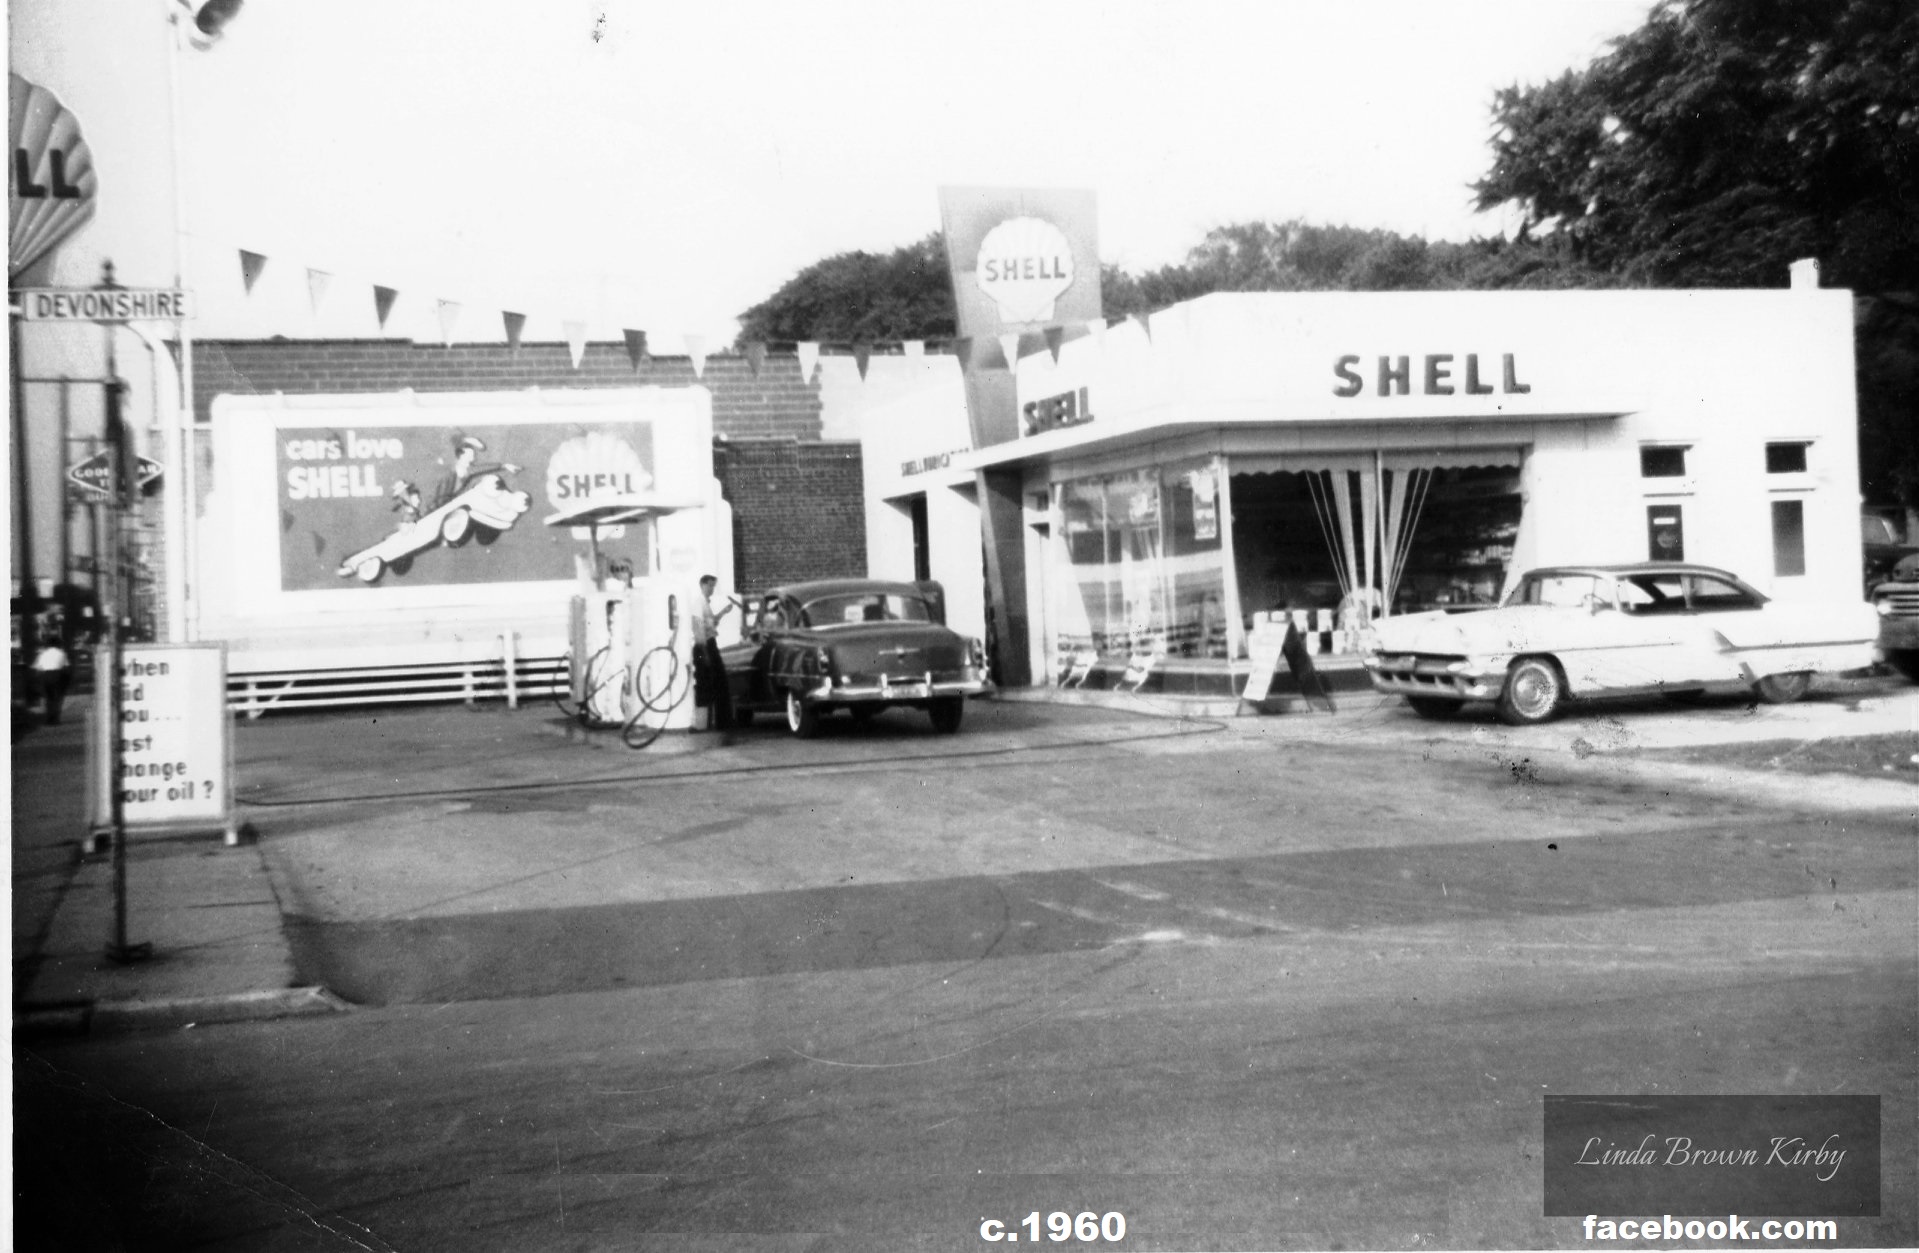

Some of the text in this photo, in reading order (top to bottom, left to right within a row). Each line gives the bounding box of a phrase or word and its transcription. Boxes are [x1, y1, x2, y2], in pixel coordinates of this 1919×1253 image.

[985, 256, 1066, 282] SHELL
[36, 293, 185, 318] DEVONSHIRE
[1332, 353, 1532, 398] SHELL
[285, 430, 404, 461] cars love
[287, 464, 383, 500] SHELL
[122, 787, 159, 804] our
[166, 780, 195, 802] oil
